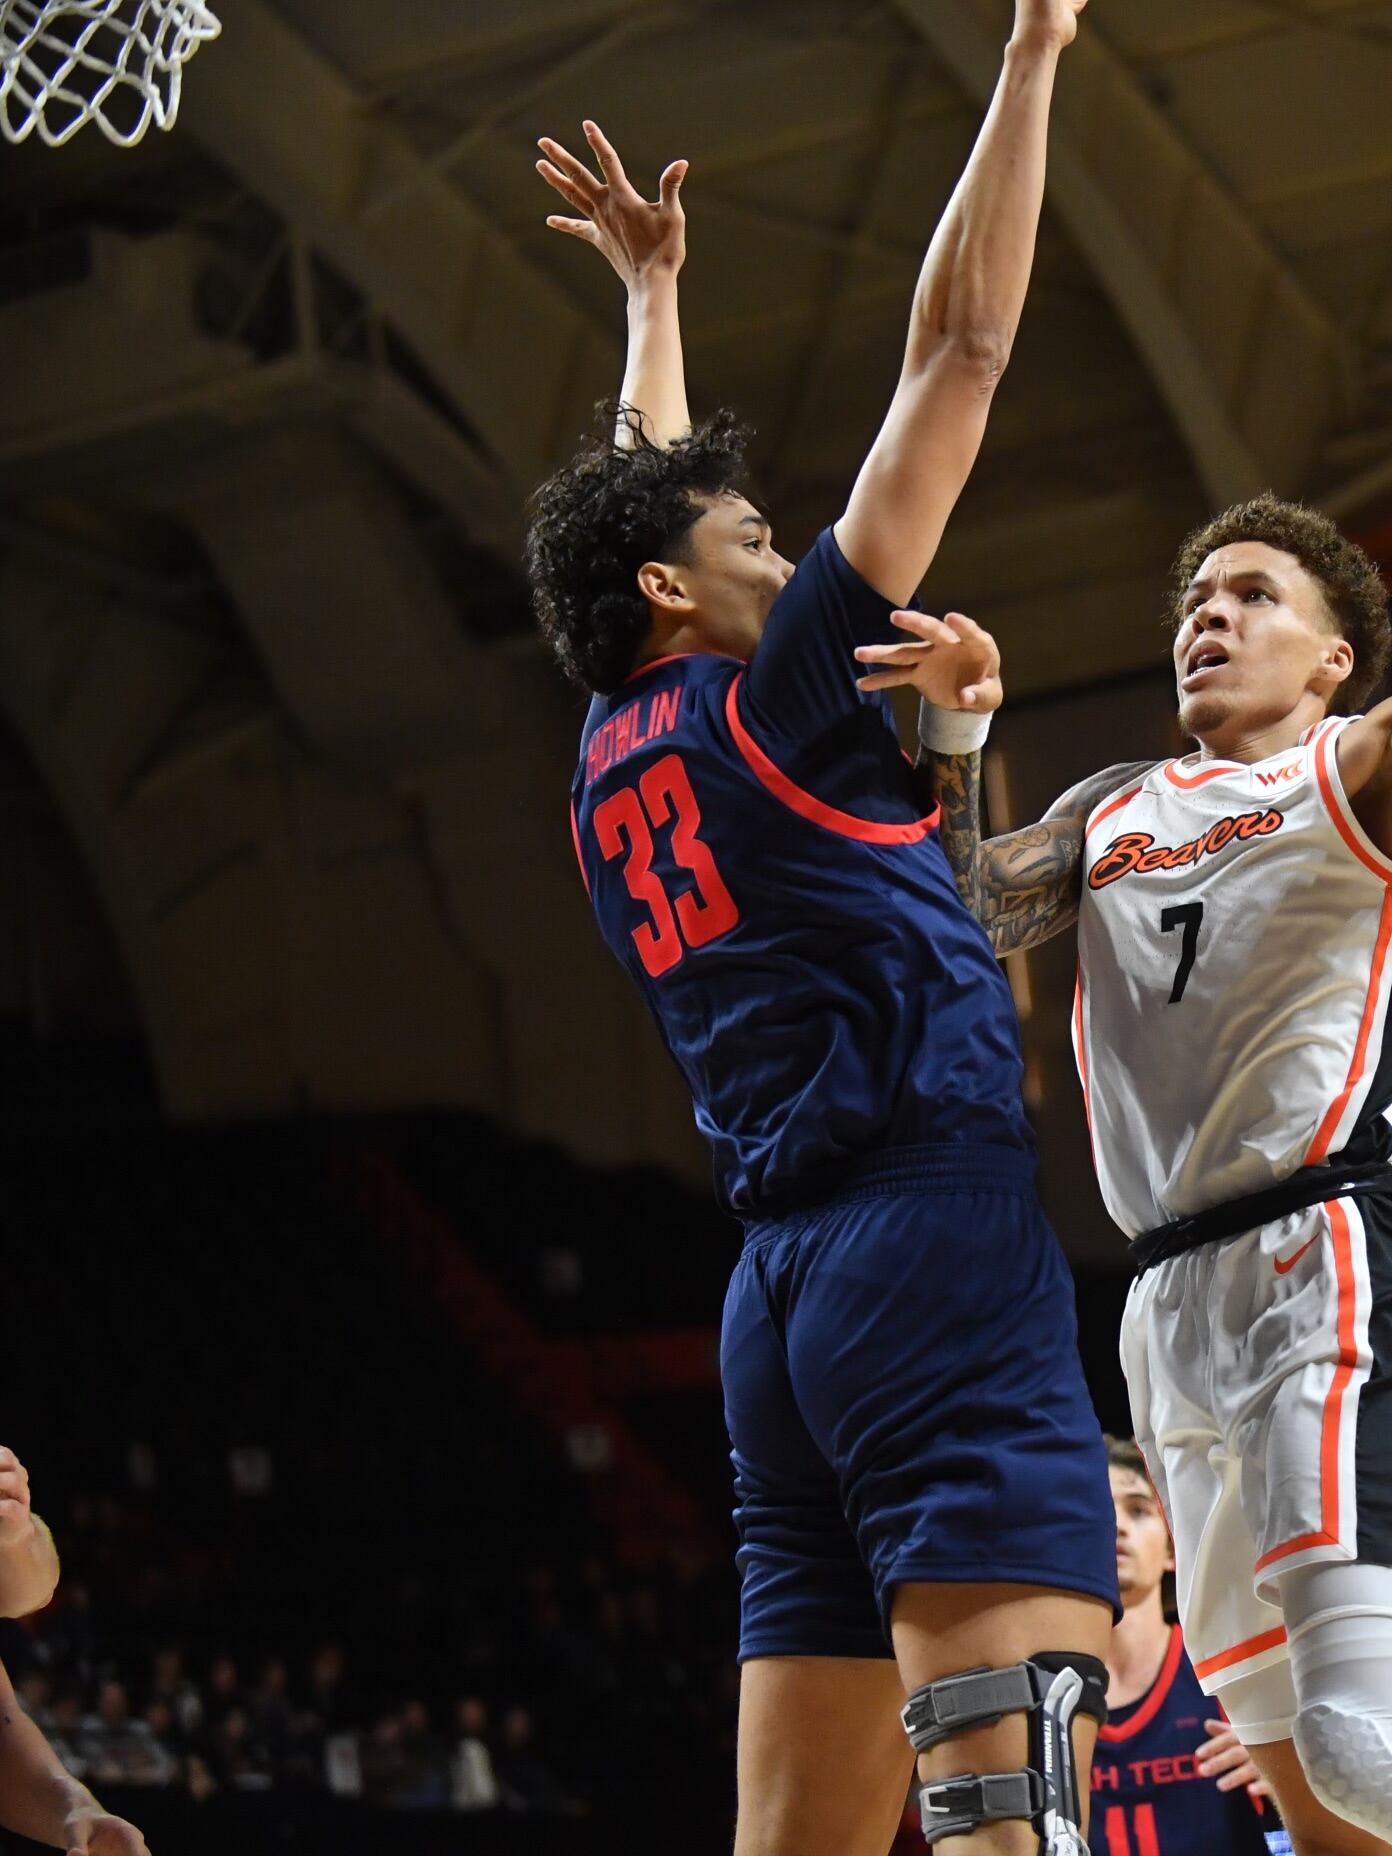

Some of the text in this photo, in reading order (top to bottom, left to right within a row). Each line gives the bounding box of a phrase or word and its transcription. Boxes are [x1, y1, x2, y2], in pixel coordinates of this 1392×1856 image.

[594, 754, 738, 978] 33
[1088, 808, 1283, 890] Beavers
[1161, 902, 1204, 1004] 7
[1104, 1802, 1162, 1856] 11
